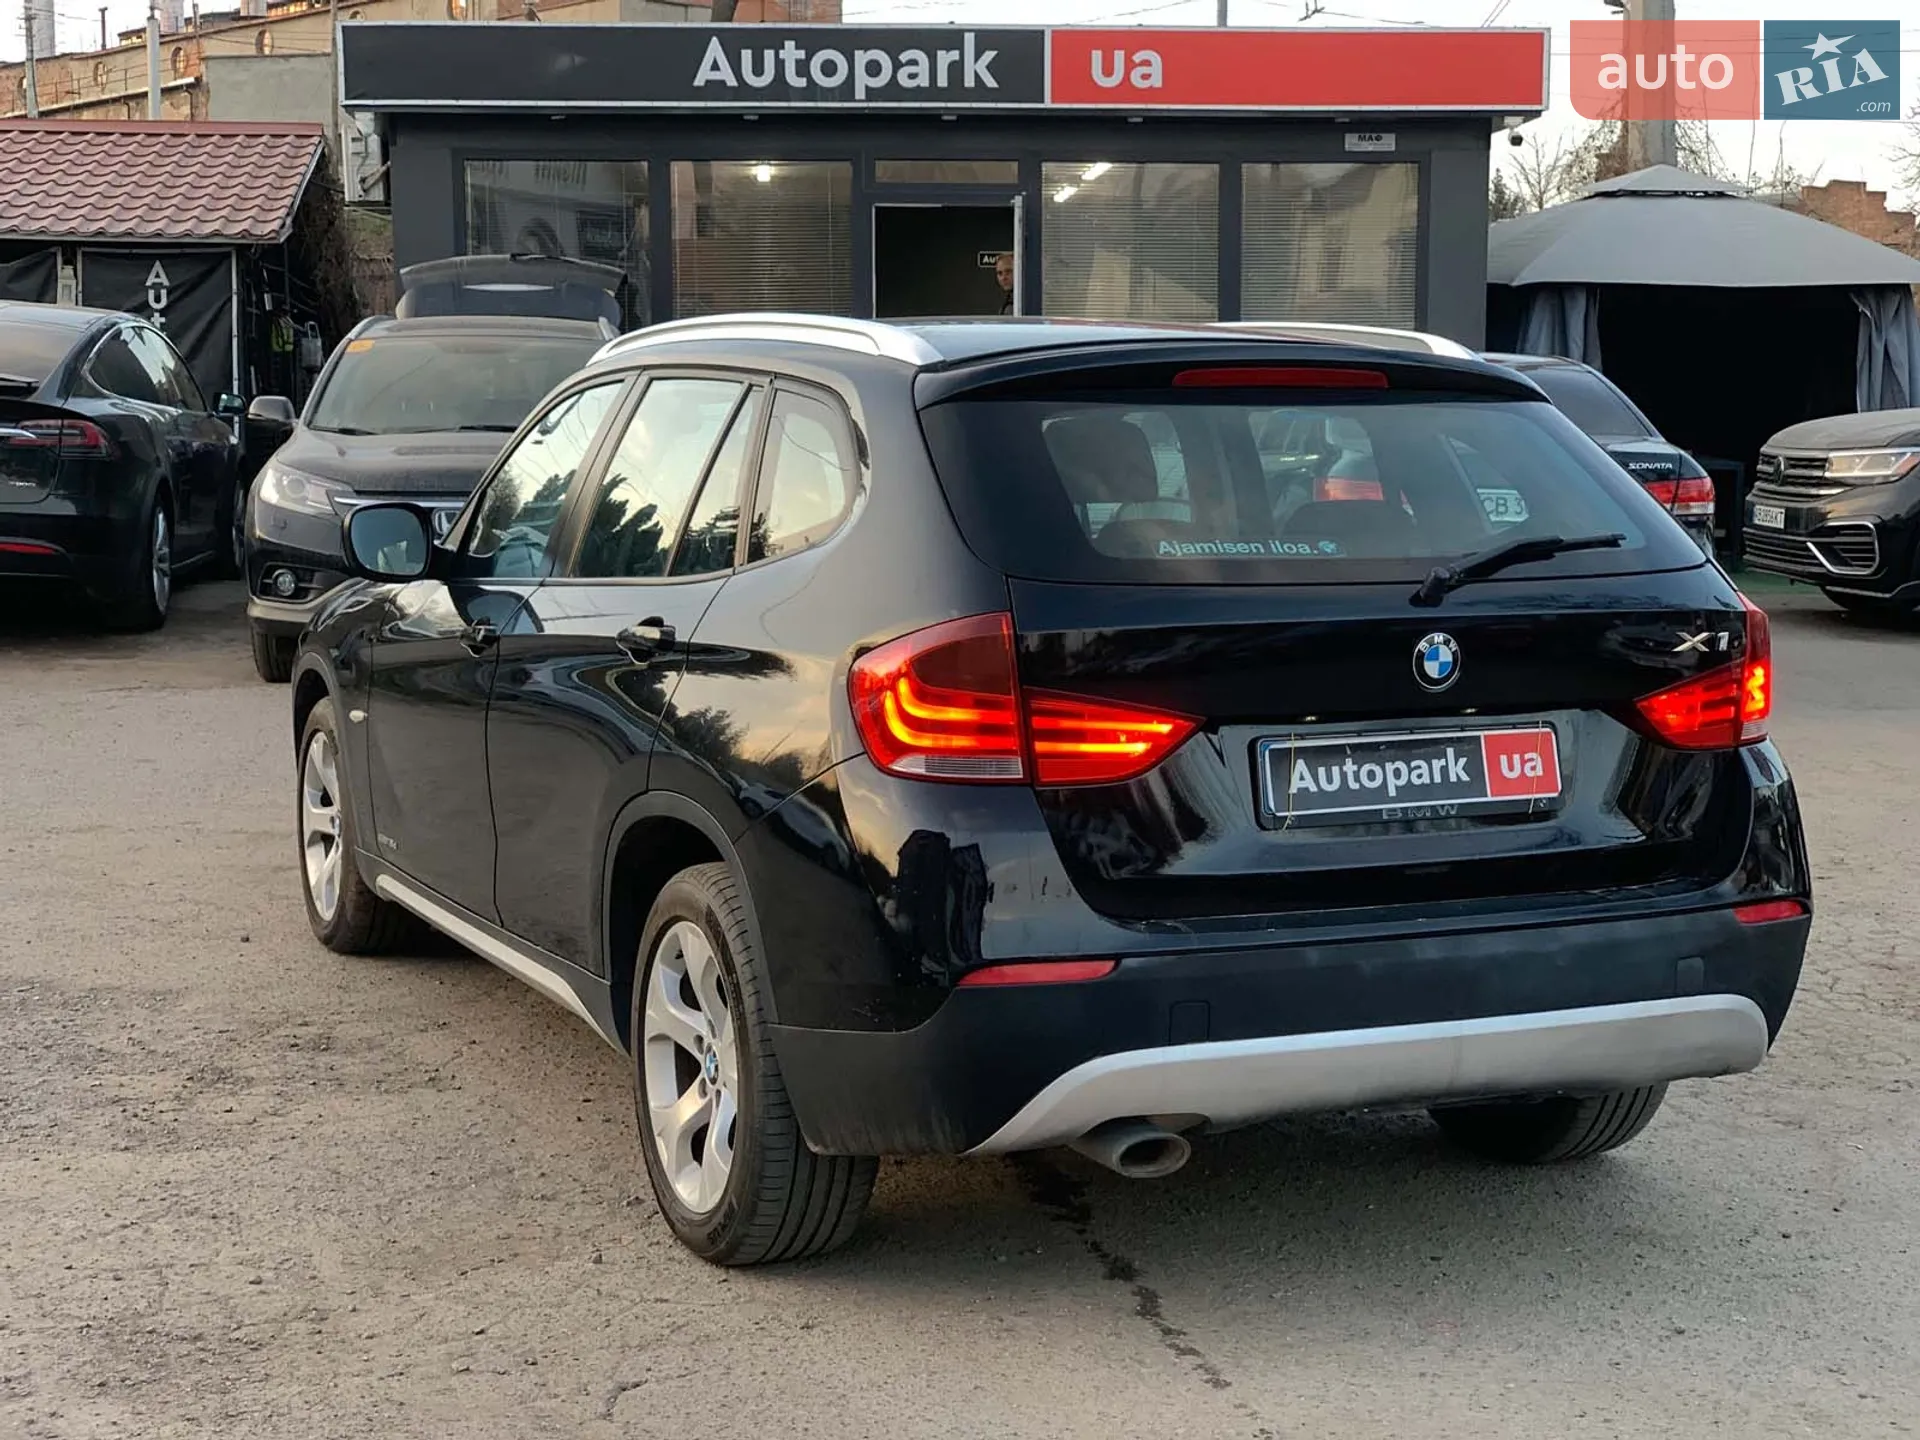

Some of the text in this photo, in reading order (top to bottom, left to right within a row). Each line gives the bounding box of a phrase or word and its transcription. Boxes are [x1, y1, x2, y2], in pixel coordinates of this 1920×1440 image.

[693, 32, 1163, 99] Autopark ua
[1628, 462, 1673, 470] SONATA
[1159, 539, 1265, 556] Ajamisen
[1671, 631, 1730, 652] X1
[1289, 748, 1544, 797] Autopark ua
[1382, 804, 1460, 820] BMW
